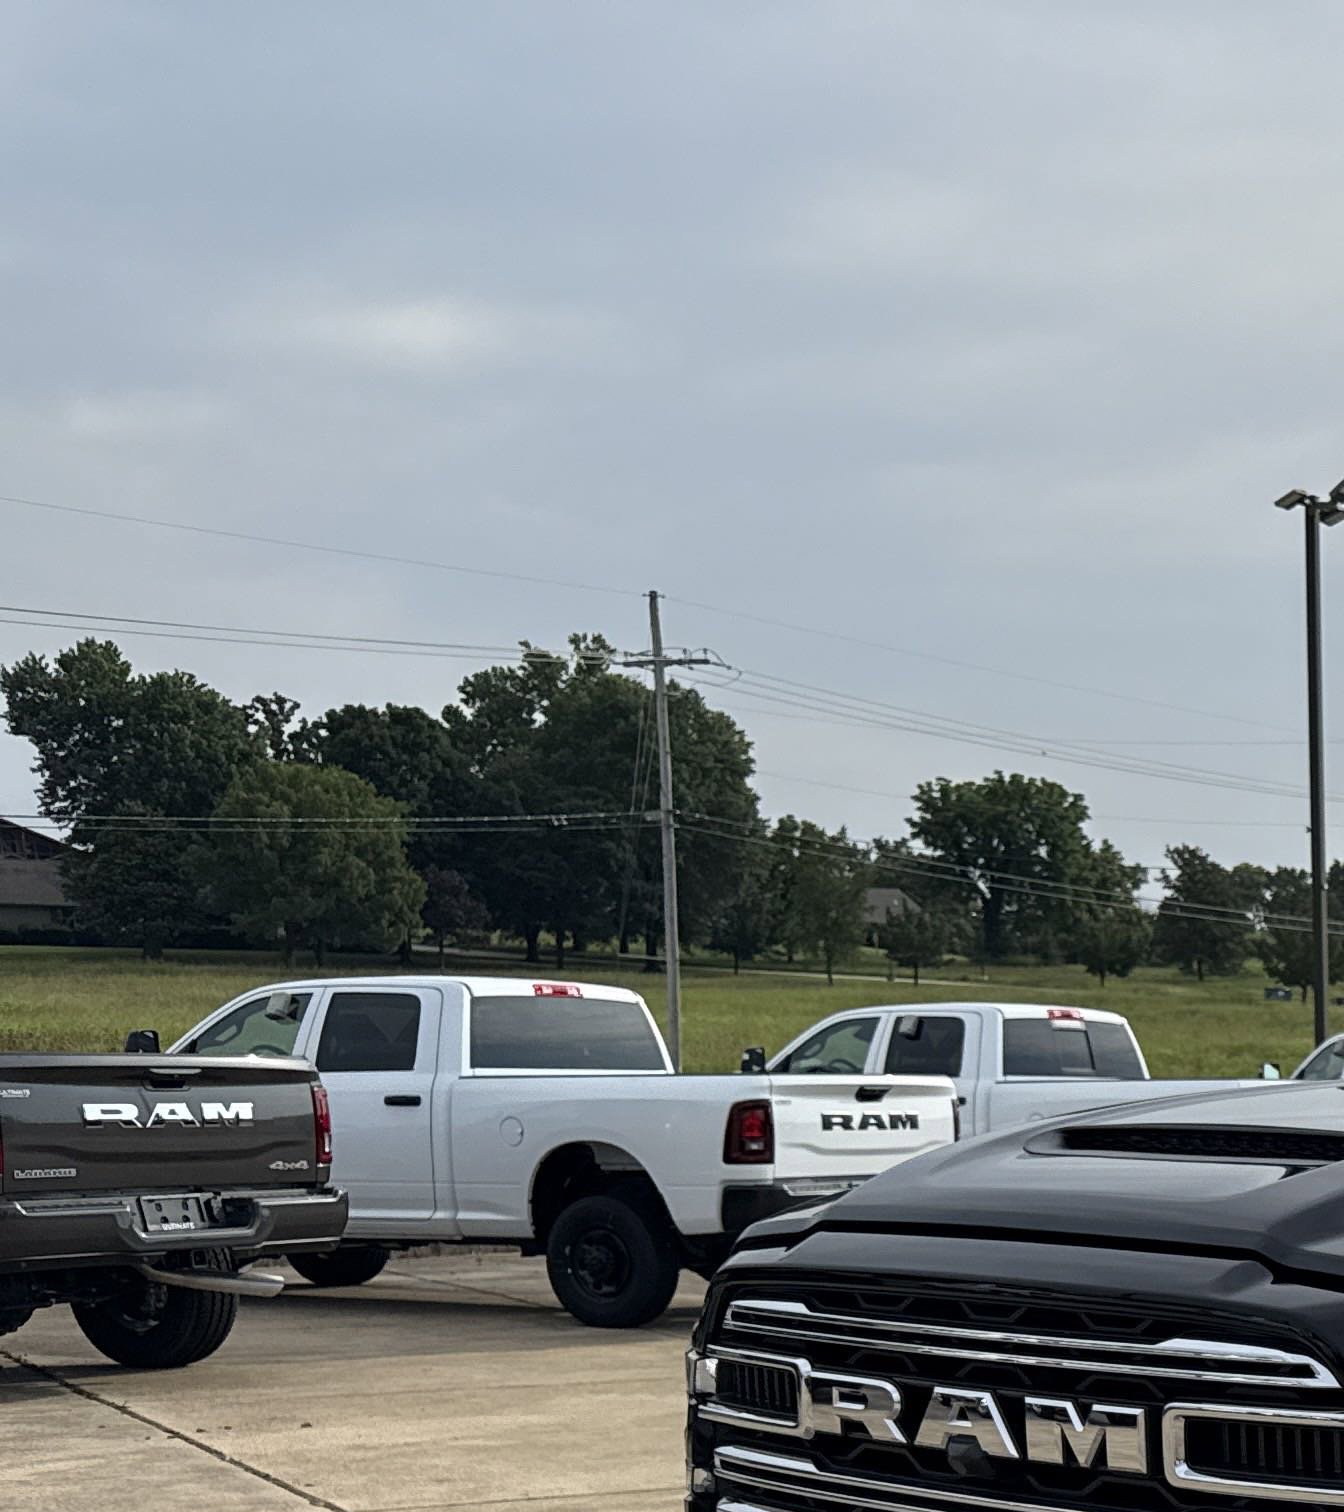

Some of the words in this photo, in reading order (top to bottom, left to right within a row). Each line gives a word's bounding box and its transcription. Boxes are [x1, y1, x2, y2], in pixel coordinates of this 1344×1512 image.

[82, 1102, 254, 1129] RAM
[821, 1112, 919, 1131] RAM
[801, 1370, 1148, 1475] RAM
